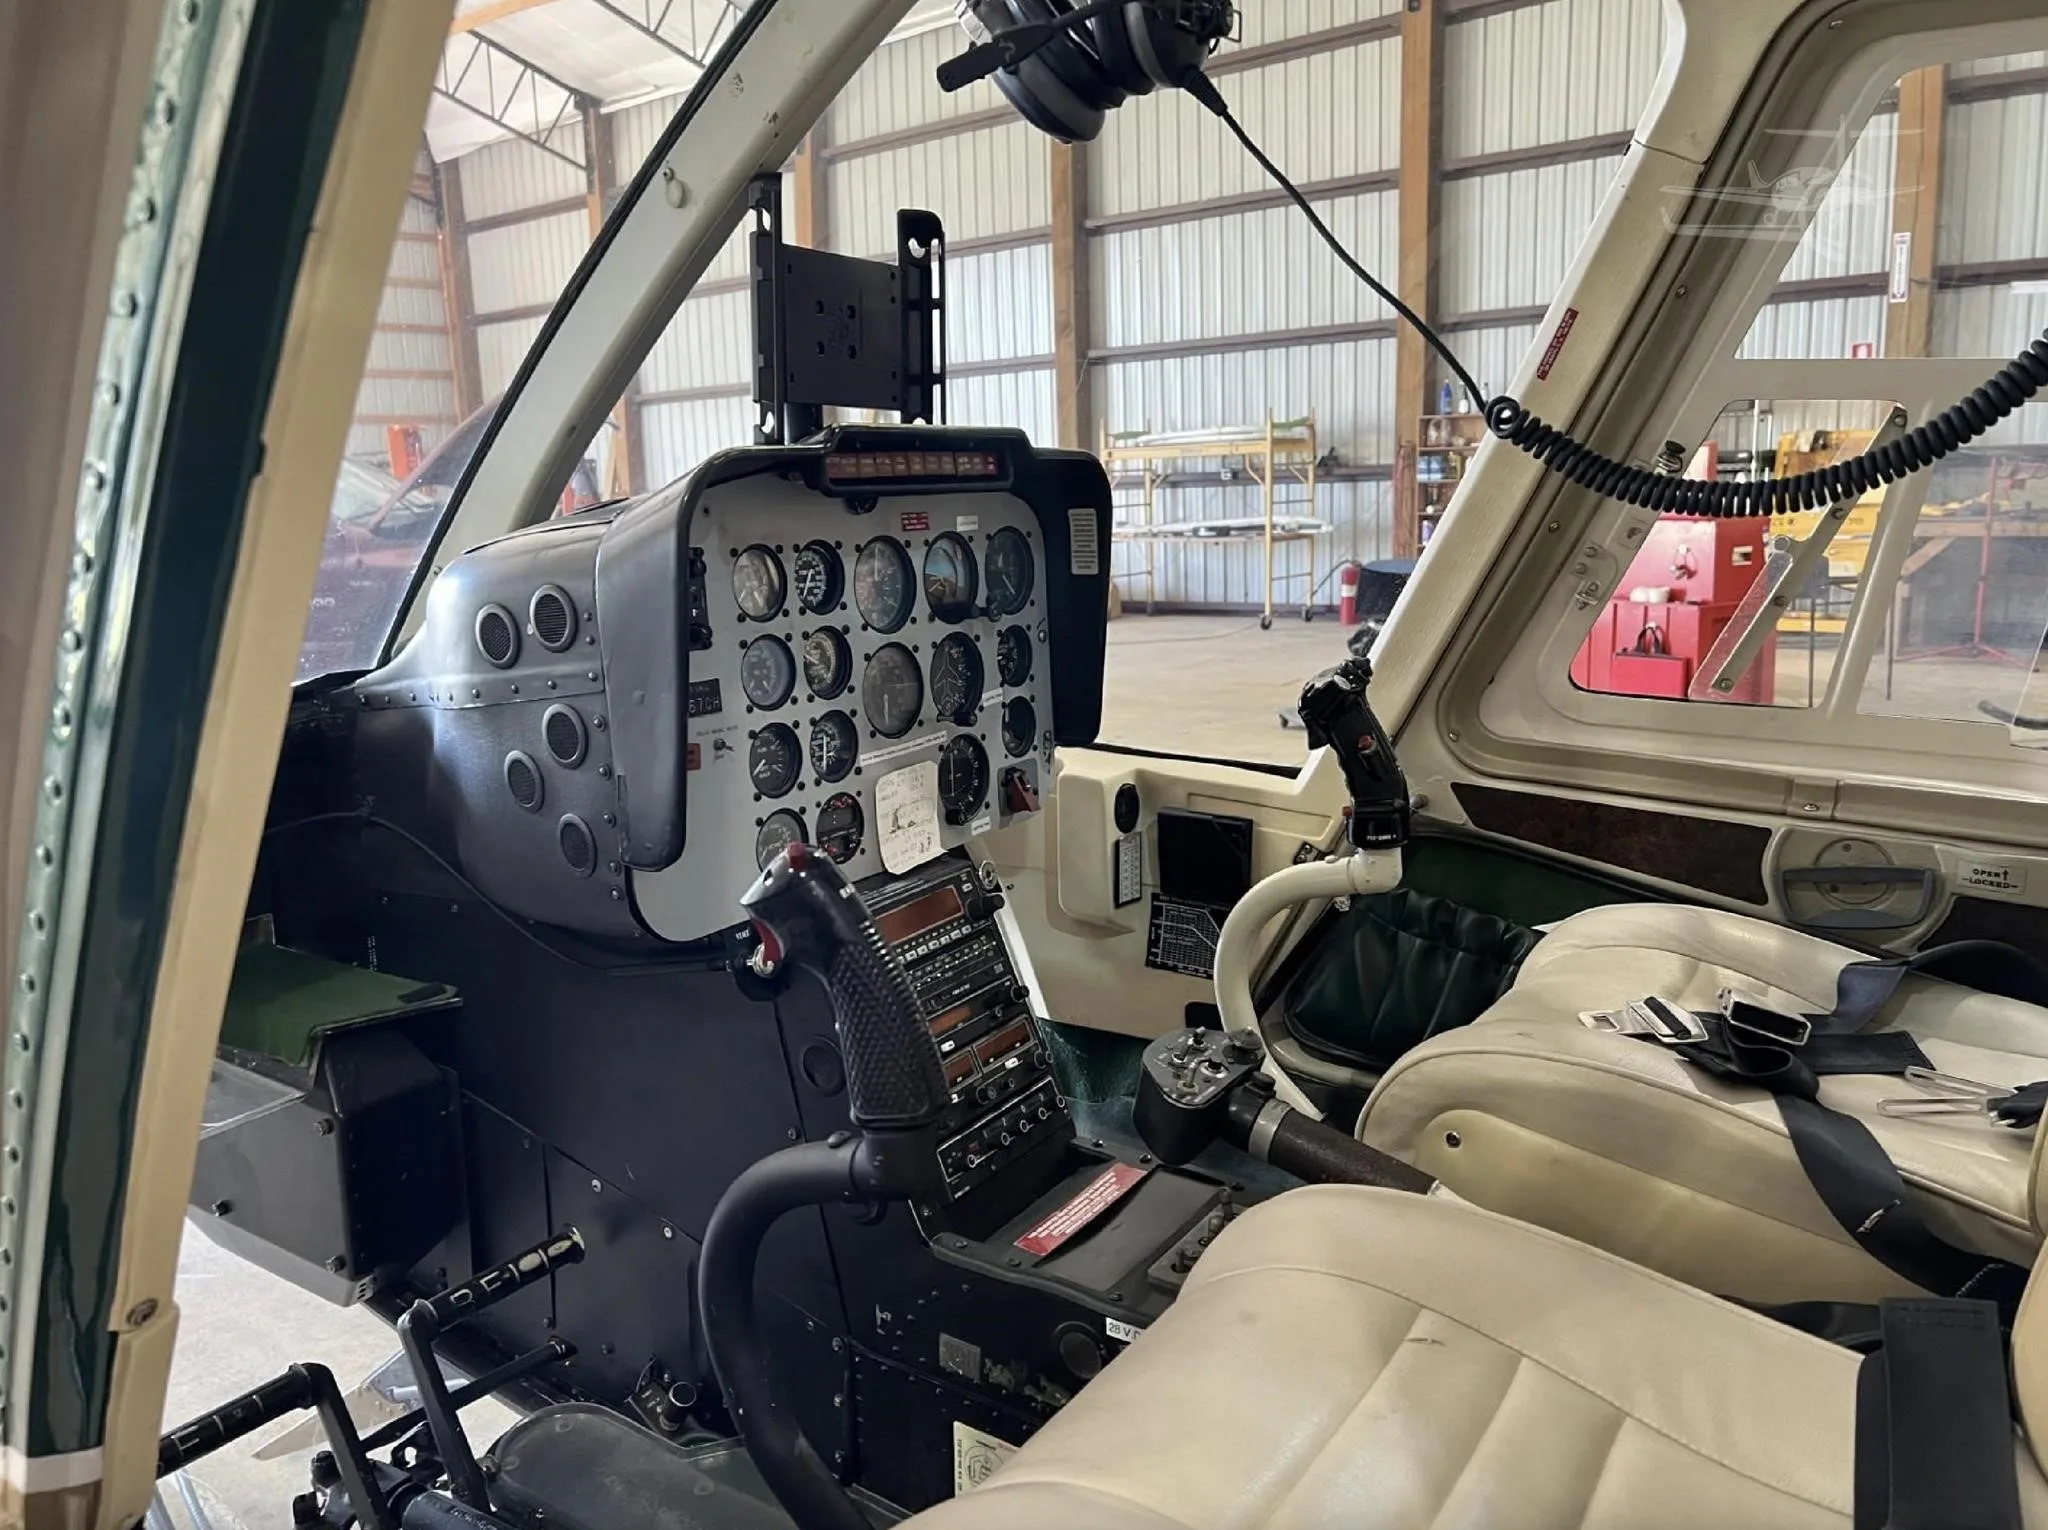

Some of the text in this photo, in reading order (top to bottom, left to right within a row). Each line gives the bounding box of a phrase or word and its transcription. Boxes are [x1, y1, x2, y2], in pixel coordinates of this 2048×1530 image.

[1972, 868, 2001, 878] OPEN
[1108, 1322, 1121, 1334] 28
[1122, 1326, 1131, 1337] V
